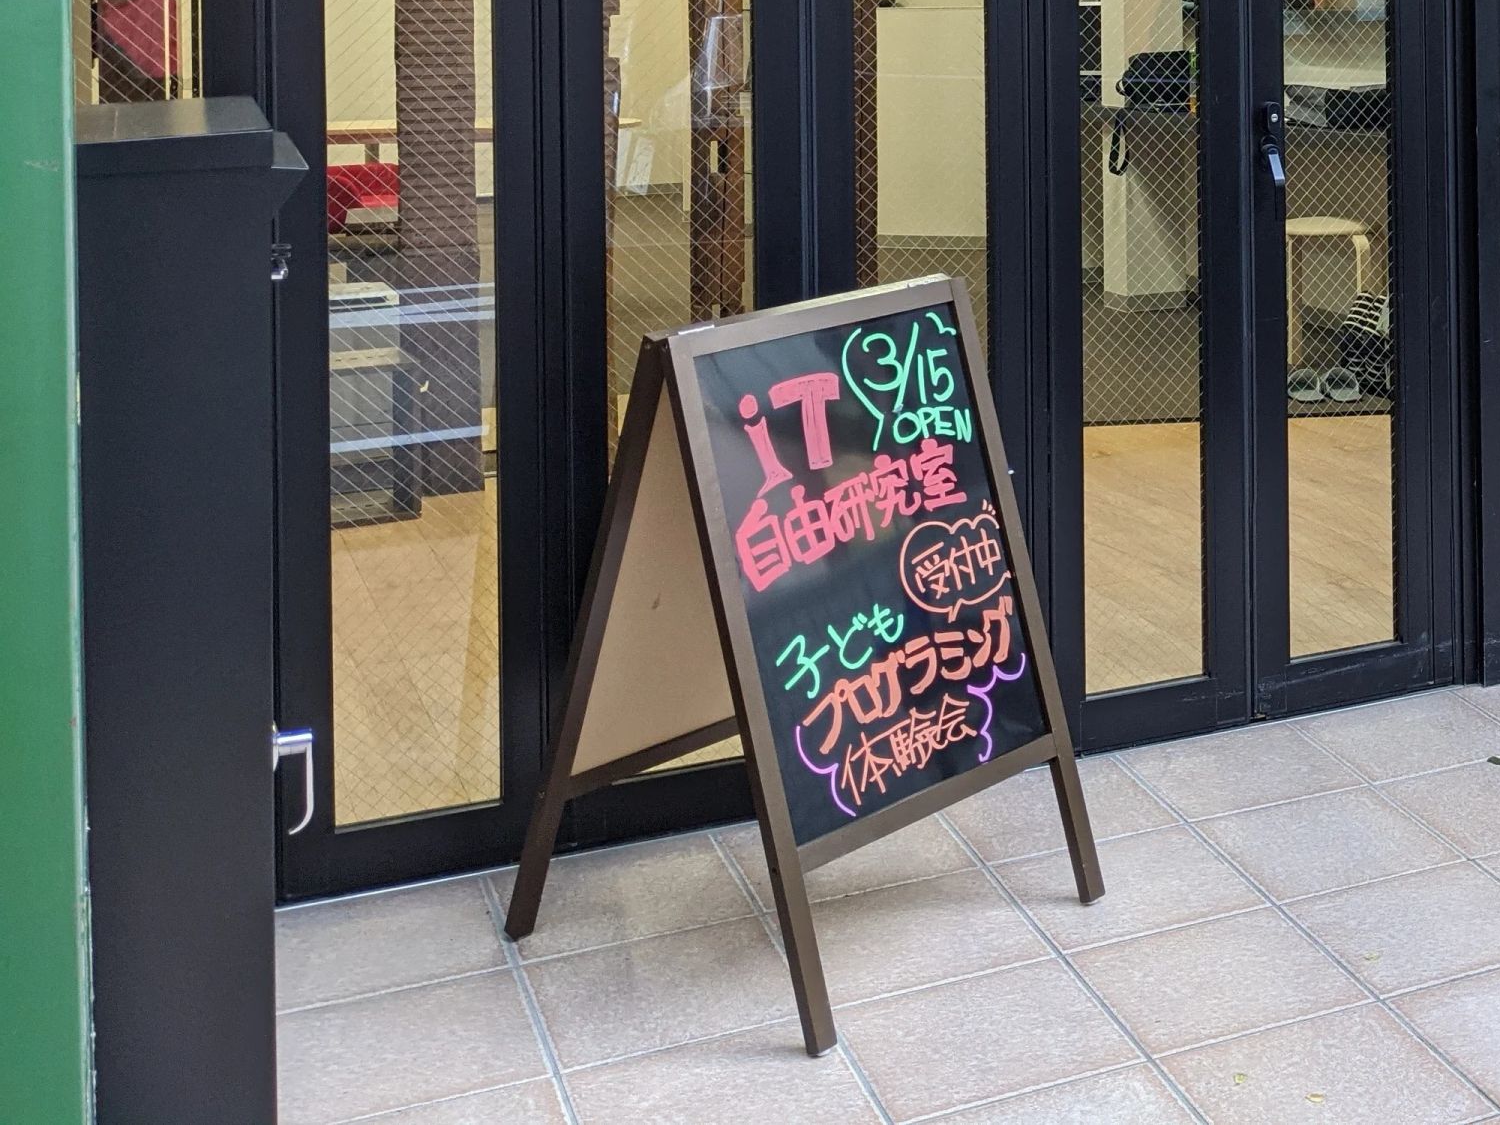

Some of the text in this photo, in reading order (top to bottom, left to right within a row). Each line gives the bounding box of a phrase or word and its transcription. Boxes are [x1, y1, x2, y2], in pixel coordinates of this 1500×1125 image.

[861, 321, 955, 406] 3/15
[892, 406, 973, 445] OPEN
[735, 437, 968, 592] 自由研究室
[911, 527, 1002, 600] 受付中
[776, 603, 904, 698] 子ども
[802, 595, 1013, 755] プログラミング
[841, 692, 978, 807] 体験会
